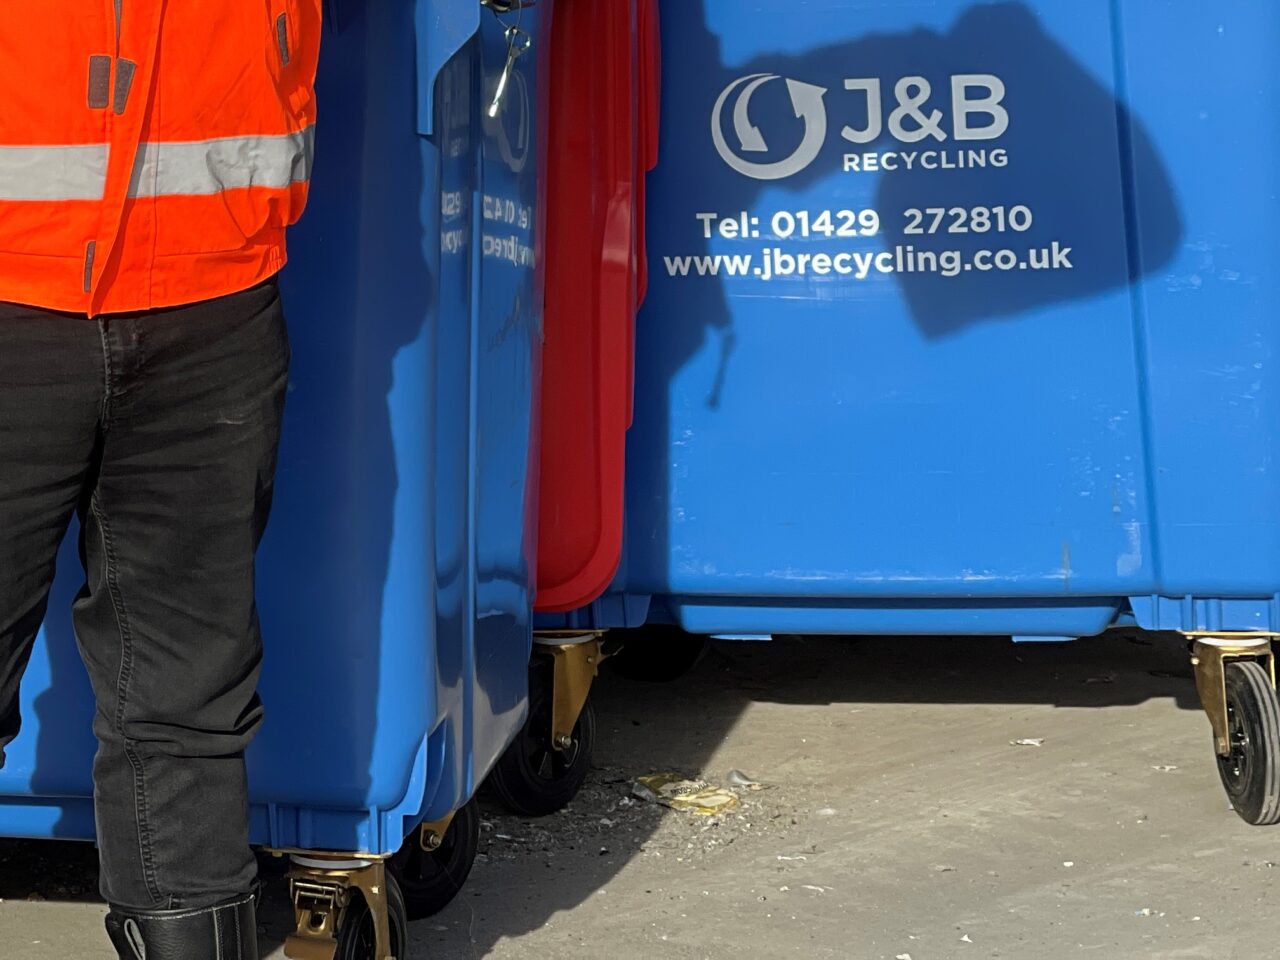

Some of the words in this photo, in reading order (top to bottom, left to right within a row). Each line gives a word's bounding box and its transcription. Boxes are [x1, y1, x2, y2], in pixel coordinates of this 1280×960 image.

[841, 74, 1009, 144] J&B
[843, 148, 1009, 173] RECYCLING
[696, 213, 761, 239] Tel:
[771, 209, 880, 238] 01429
[903, 205, 1033, 235] 272810
[663, 241, 1073, 279] www.jbrecycling.co.uk
